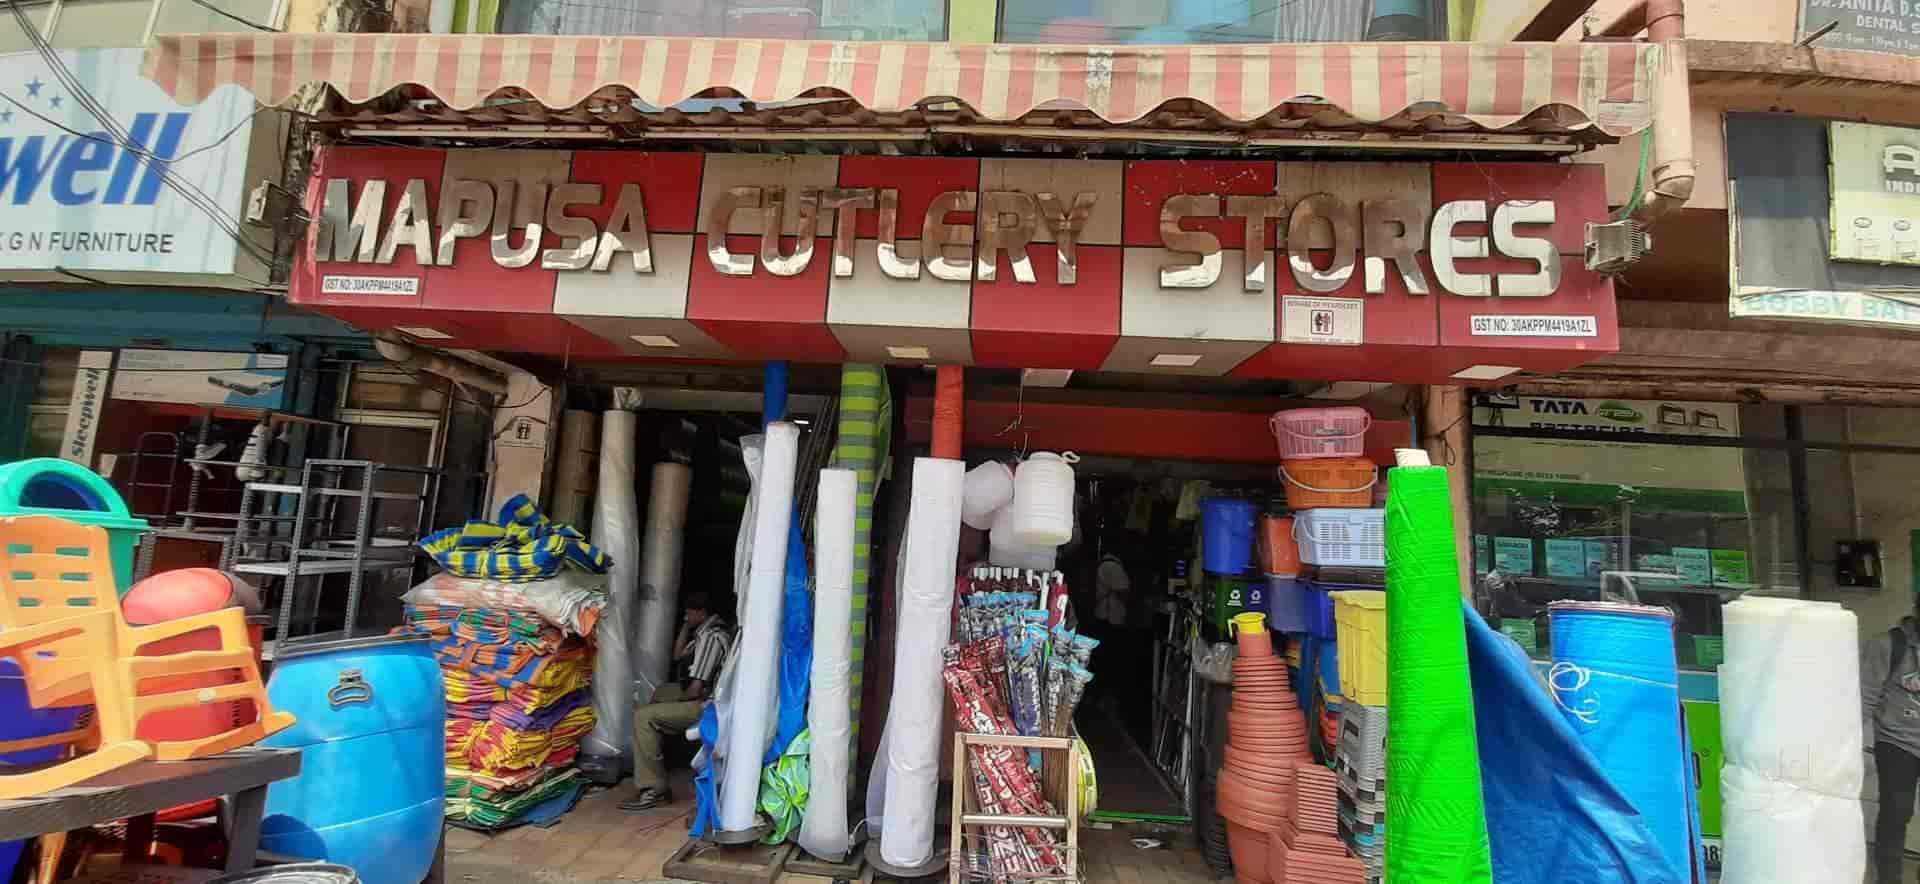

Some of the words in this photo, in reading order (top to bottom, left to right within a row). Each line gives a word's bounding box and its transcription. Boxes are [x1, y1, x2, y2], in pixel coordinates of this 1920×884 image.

[1856, 14, 1905, 32] DENTAL
[9, 231, 24, 250] G
[29, 231, 43, 250] N
[49, 231, 174, 253] FURNITURE
[316, 178, 653, 273] MAPUSA
[706, 185, 1097, 284] CUTLERY
[1159, 193, 1562, 296] STORES
[1744, 294, 1849, 314] BOBBY
[1474, 318, 1491, 331] GST
[1529, 399, 1588, 415] TATA
